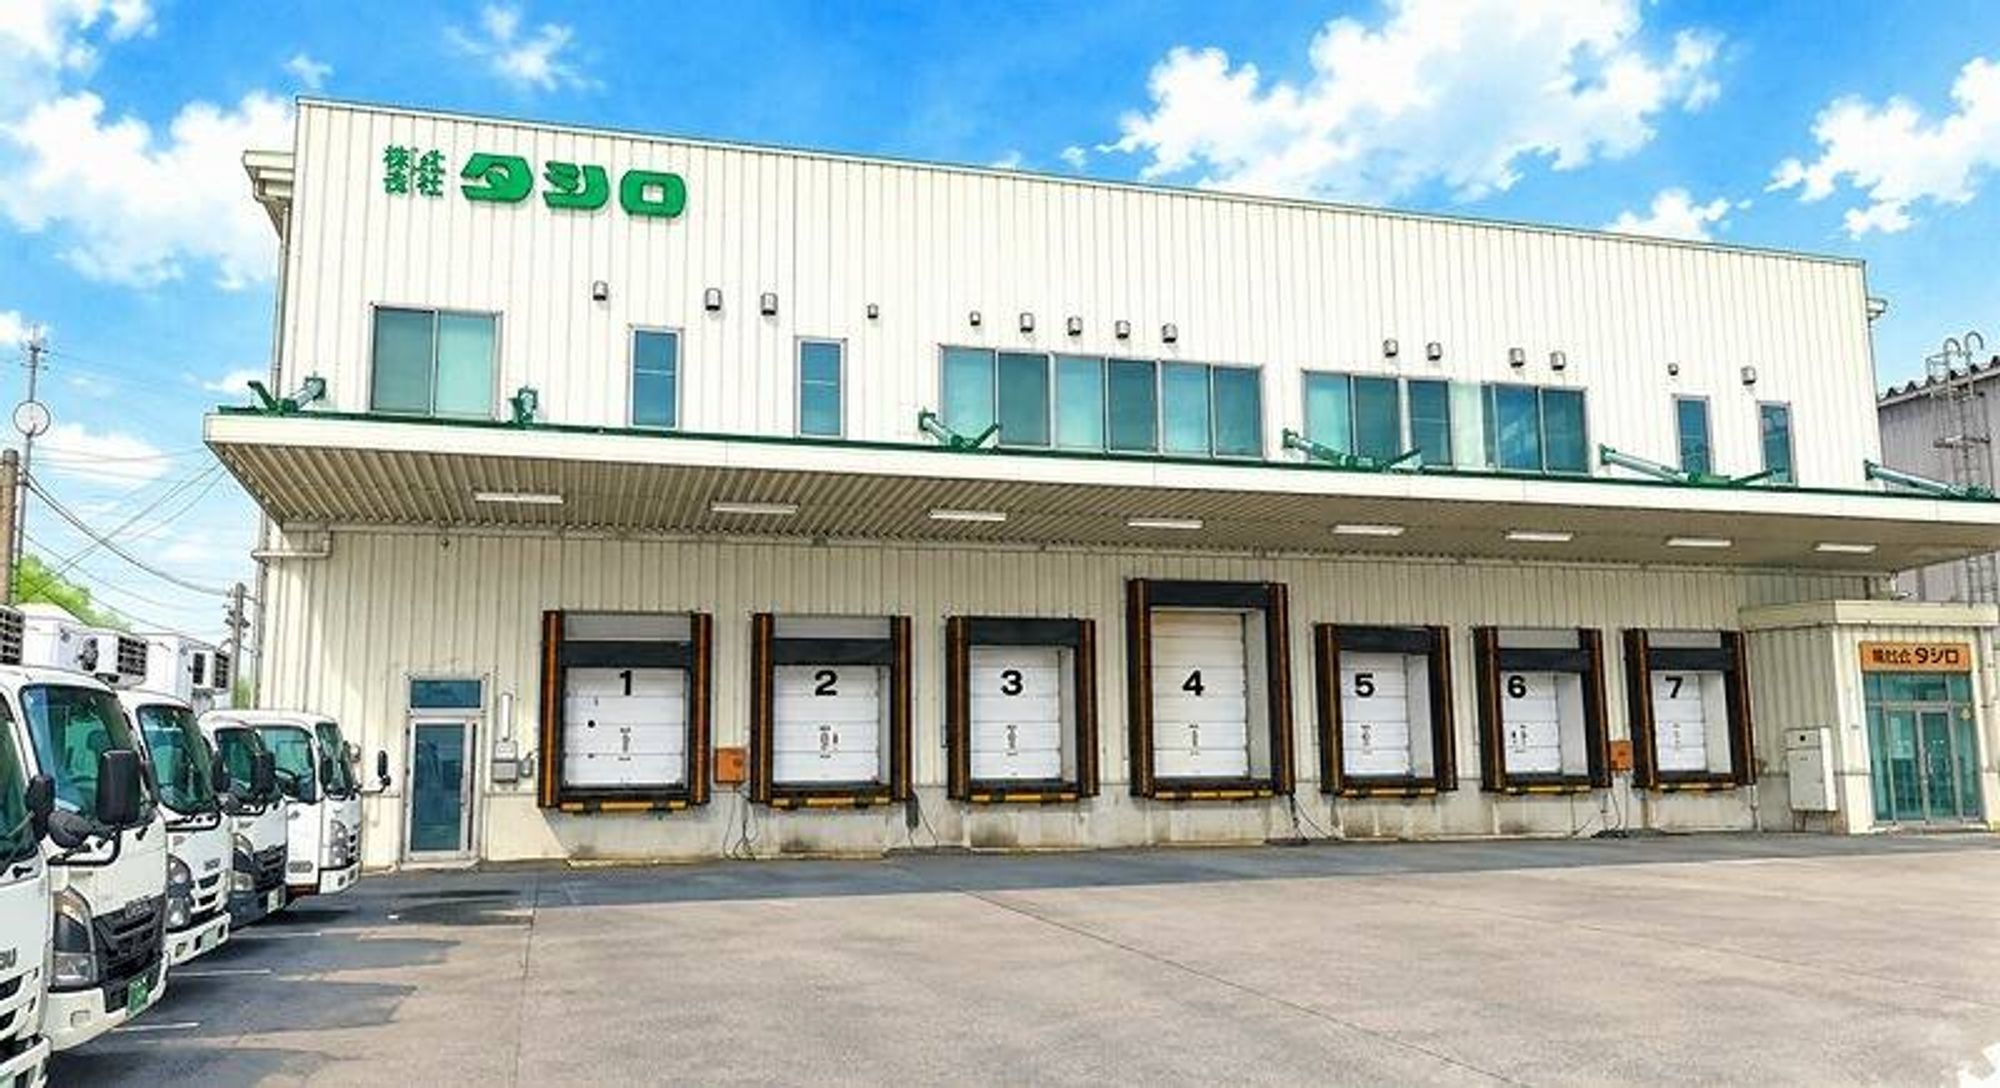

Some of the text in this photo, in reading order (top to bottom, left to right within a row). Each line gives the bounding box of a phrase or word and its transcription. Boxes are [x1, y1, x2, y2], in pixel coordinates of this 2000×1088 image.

[460, 152, 687, 219] タシロ
[619, 670, 632, 696] 1
[814, 669, 838, 696] 2
[1001, 669, 1024, 696] 3
[1182, 669, 1205, 697] 4
[1354, 672, 1376, 698] 5
[1507, 674, 1527, 699] 6
[1665, 675, 1684, 699] 7
